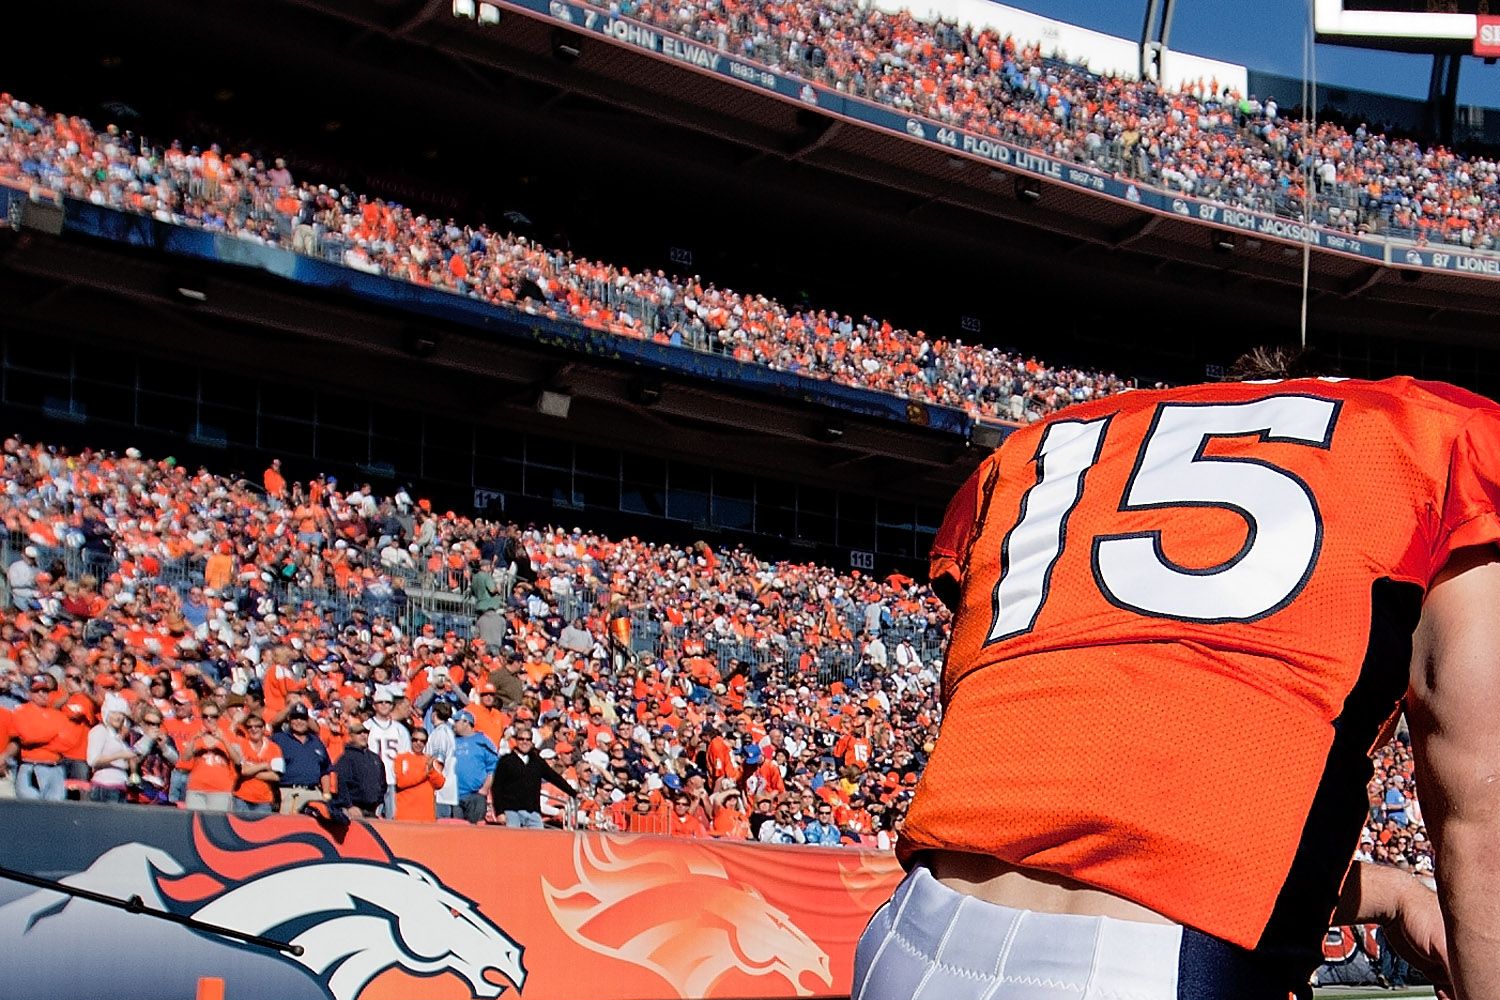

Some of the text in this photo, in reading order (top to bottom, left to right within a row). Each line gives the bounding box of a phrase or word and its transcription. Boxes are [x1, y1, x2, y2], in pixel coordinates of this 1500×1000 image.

[583, 9, 598, 28] 7
[603, 17, 657, 50] JOHN
[663, 37, 720, 70] ELWAY
[936, 127, 957, 147] 44
[963, 135, 1009, 162] FLOYD
[1015, 151, 1062, 179] LITTLE
[1199, 204, 1217, 221] 87
[1223, 208, 1256, 229] RICH
[1259, 219, 1321, 245] JACKSON
[1432, 252, 1450, 268] 87
[985, 393, 1344, 647] 15
[851, 552, 872, 568] 115
[376, 739, 399, 761] 15
[854, 744, 869, 762] 15
